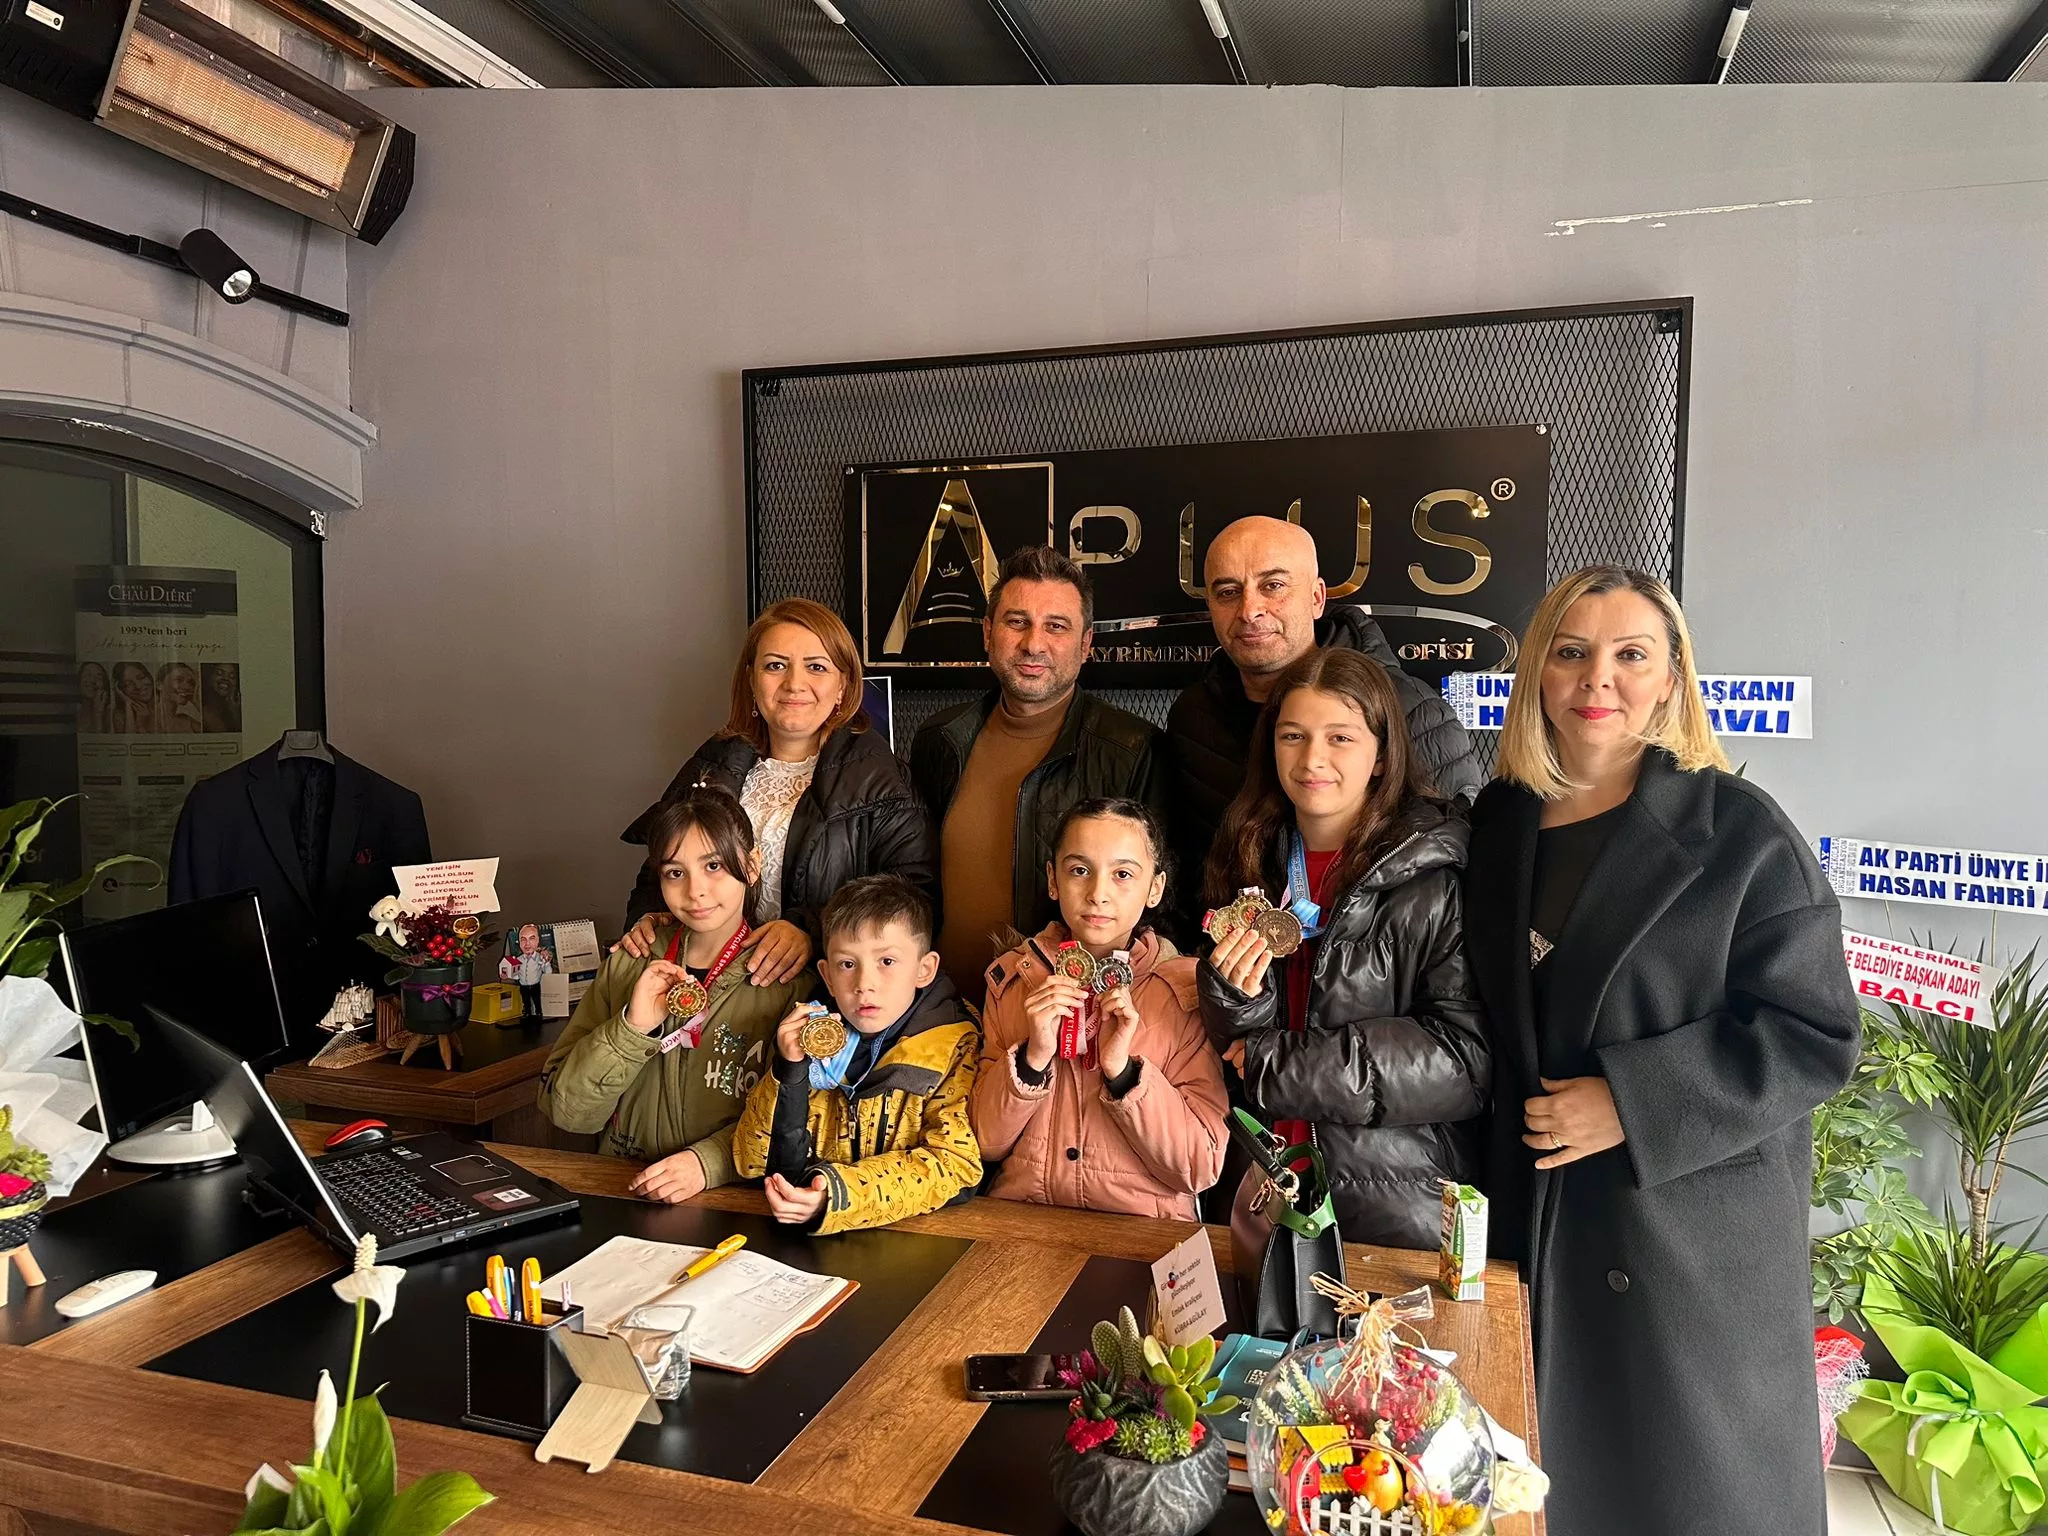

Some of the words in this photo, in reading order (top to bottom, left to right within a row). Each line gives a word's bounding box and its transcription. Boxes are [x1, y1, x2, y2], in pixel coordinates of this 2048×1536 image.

[1398, 637, 1475, 661] OFİSİ
[1476, 676, 1515, 698] ÜN
[1859, 847, 1890, 868] AK
[1895, 850, 1962, 875] PARTİ
[1968, 853, 2029, 882] ÜNYE
[1859, 873, 1946, 900] HASAN
[1954, 881, 2035, 909] FAHRİ
[1850, 935, 1982, 974] DİLEKLERİMLE
[1854, 949, 1903, 980] BELEDİYE
[1904, 963, 1947, 990] BAŞKAN
[1947, 974, 1981, 999] ADAYI
[1858, 979, 1975, 1022] BALCI
